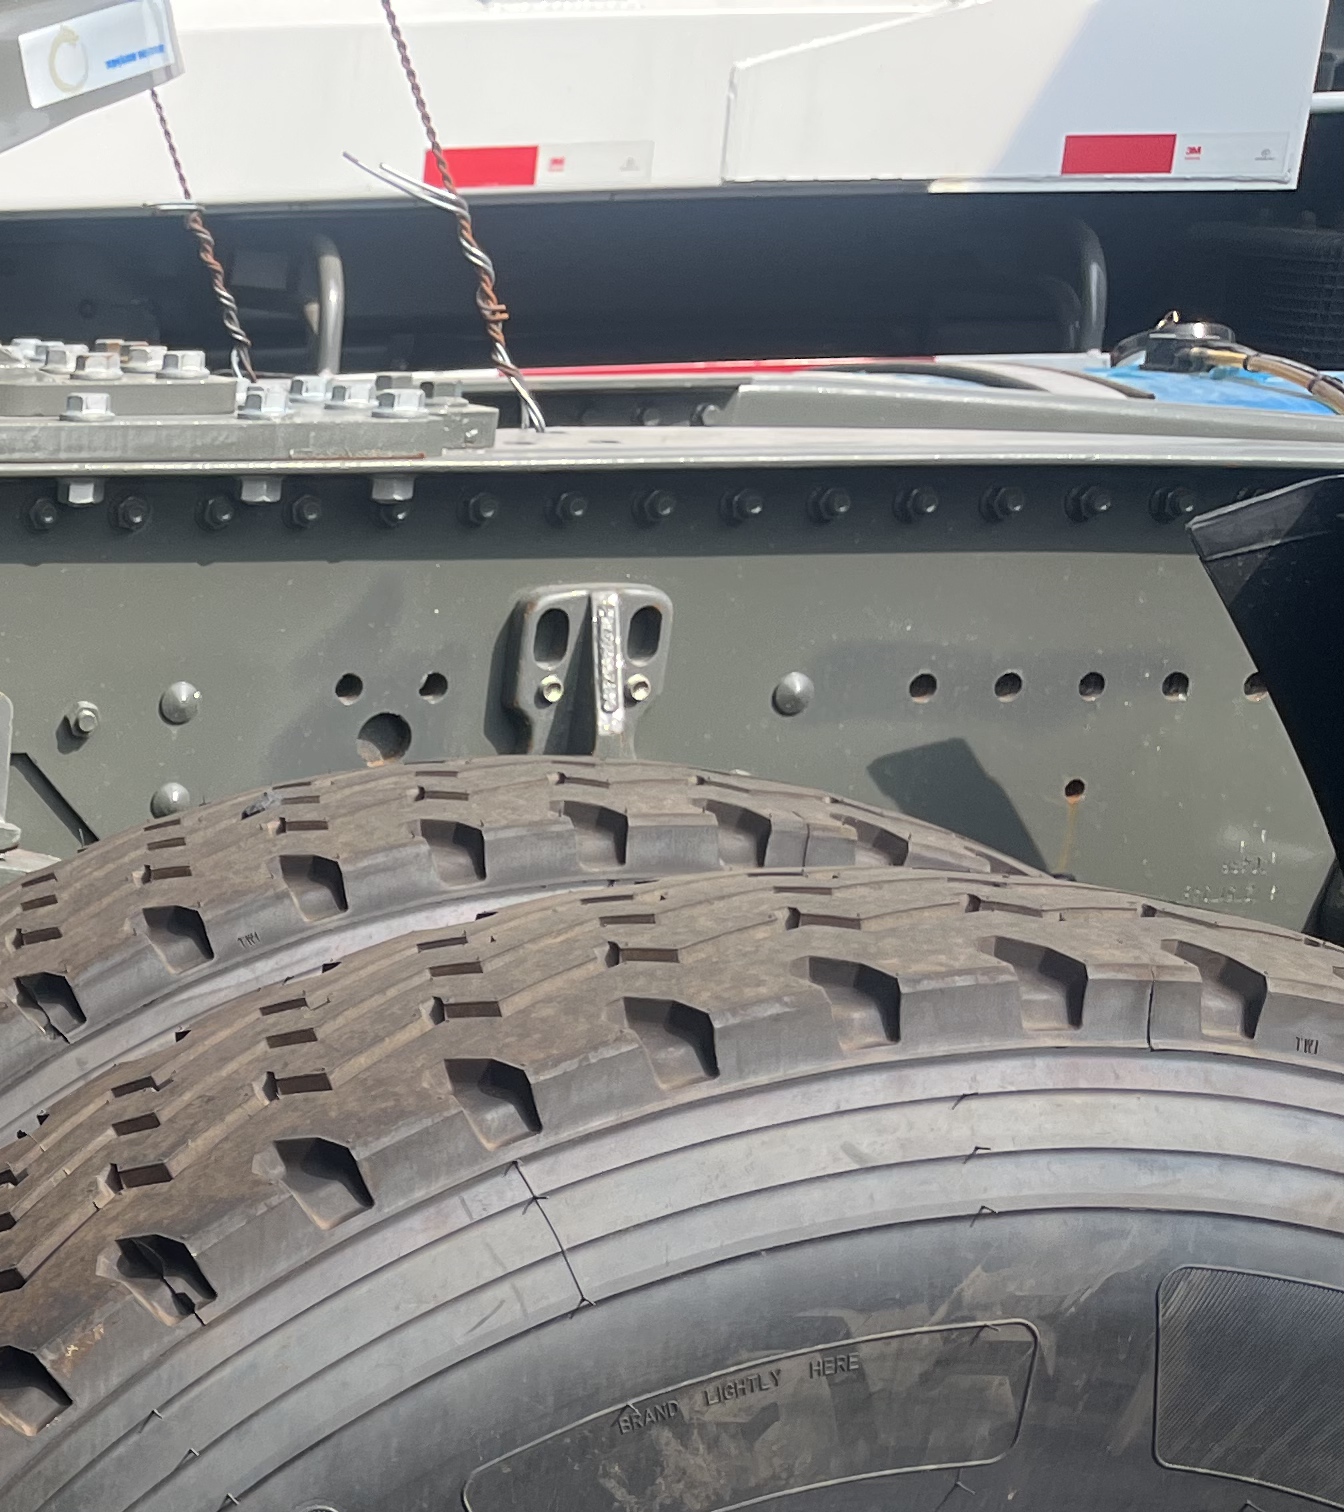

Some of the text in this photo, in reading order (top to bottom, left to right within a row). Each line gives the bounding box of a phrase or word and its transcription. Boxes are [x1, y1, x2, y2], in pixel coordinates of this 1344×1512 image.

[1296, 1036, 1319, 1055] TWI
[617, 1351, 861, 1436] BRAND LIGHTLY HERE
